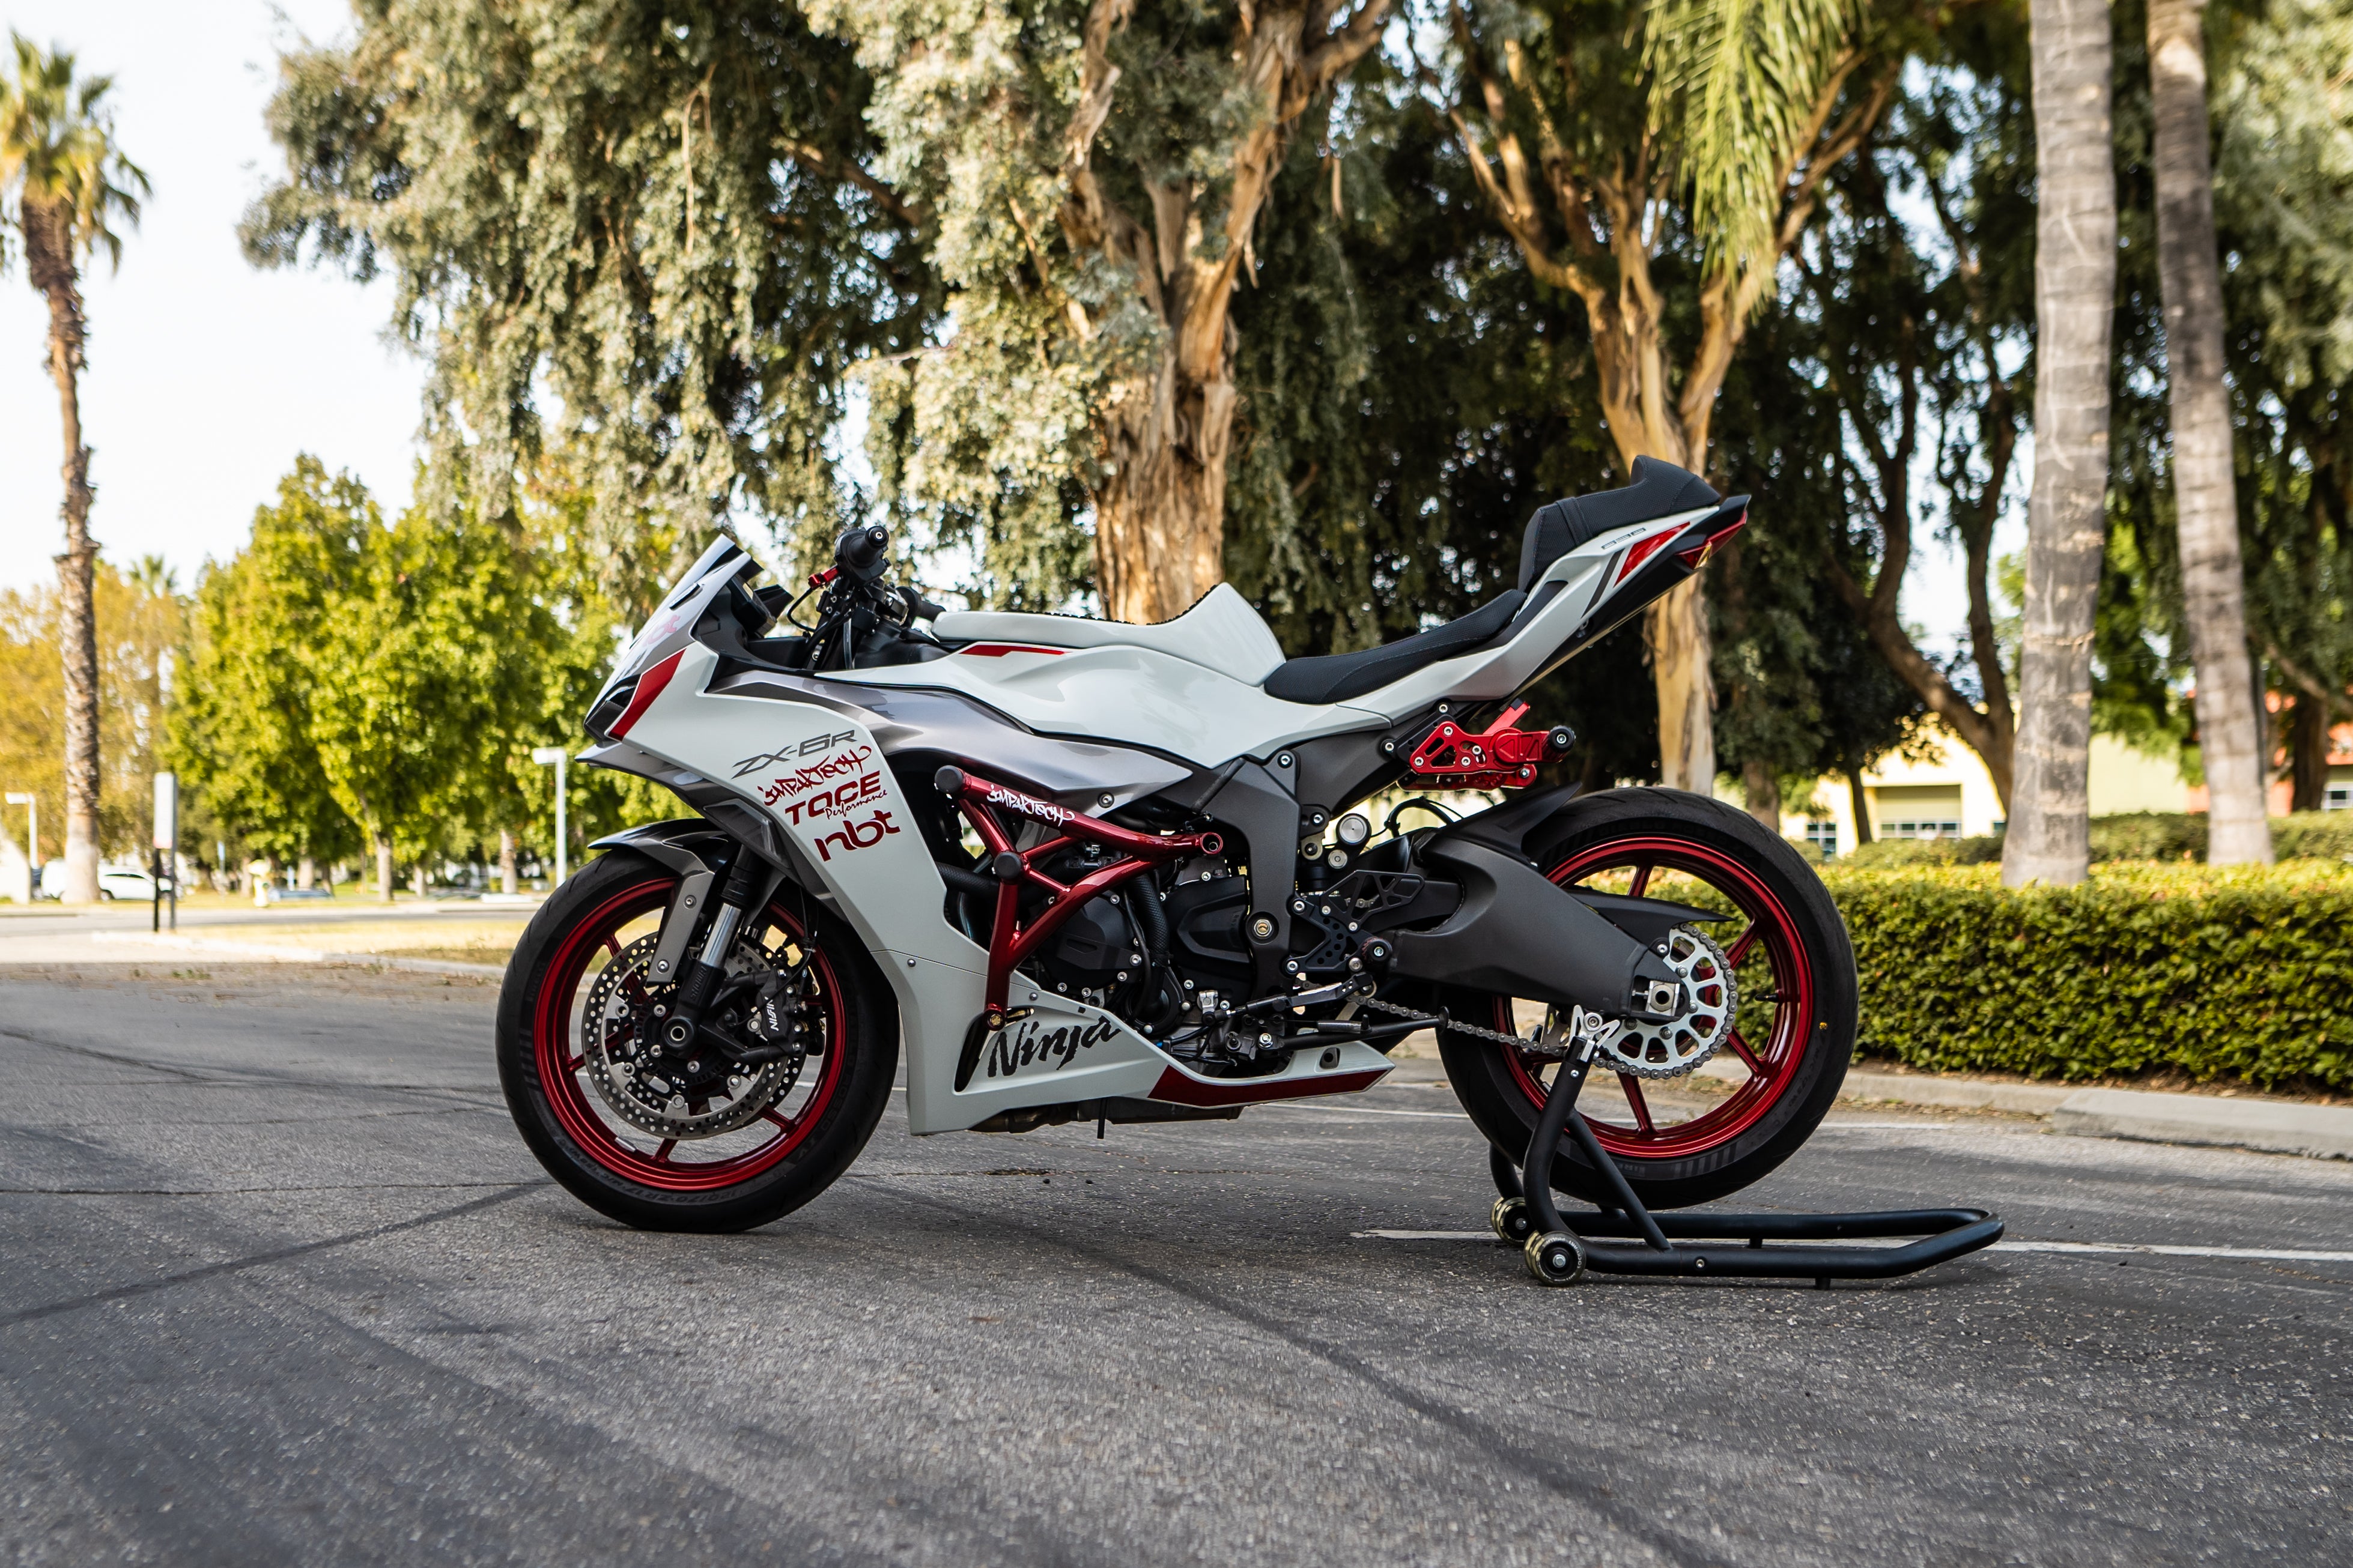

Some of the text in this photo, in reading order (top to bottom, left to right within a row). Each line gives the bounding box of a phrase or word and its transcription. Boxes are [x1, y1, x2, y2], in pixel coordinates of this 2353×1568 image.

[730, 729, 857, 780] ZX-6R
[785, 770, 882, 826] TOCE
[825, 790, 888, 820] Performance
[814, 810, 900, 862] nbt
[764, 995, 779, 1032] NISSIN
[987, 1016, 1122, 1078] Ninja
